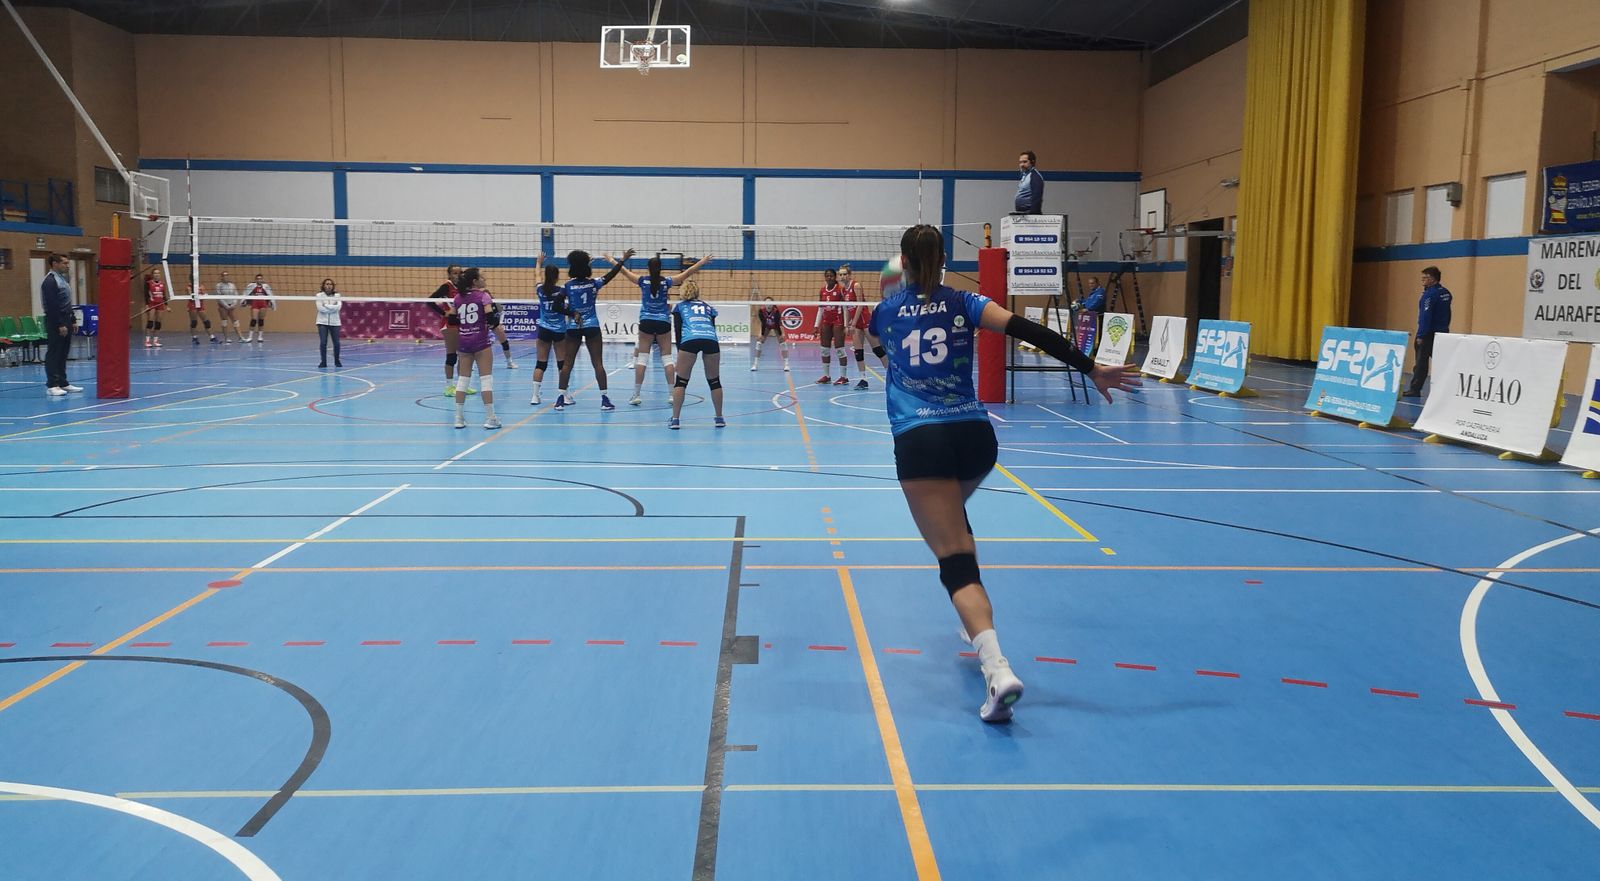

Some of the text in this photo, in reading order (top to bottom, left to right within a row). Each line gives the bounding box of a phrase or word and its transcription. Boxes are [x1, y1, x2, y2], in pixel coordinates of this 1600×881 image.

[1541, 241, 1600, 259] MAIRENA
[1558, 273, 1582, 290] DEL
[580, 292, 588, 304] 1
[457, 302, 479, 324] 18
[690, 304, 706, 314] 11
[1534, 305, 1600, 323] ALJARAFE
[715, 322, 749, 333] macia
[902, 327, 948, 366] 13
[1151, 357, 1170, 368] RENAULT
[1456, 372, 1522, 406] MAJAO
[1460, 430, 1488, 440] ANDALUZA
